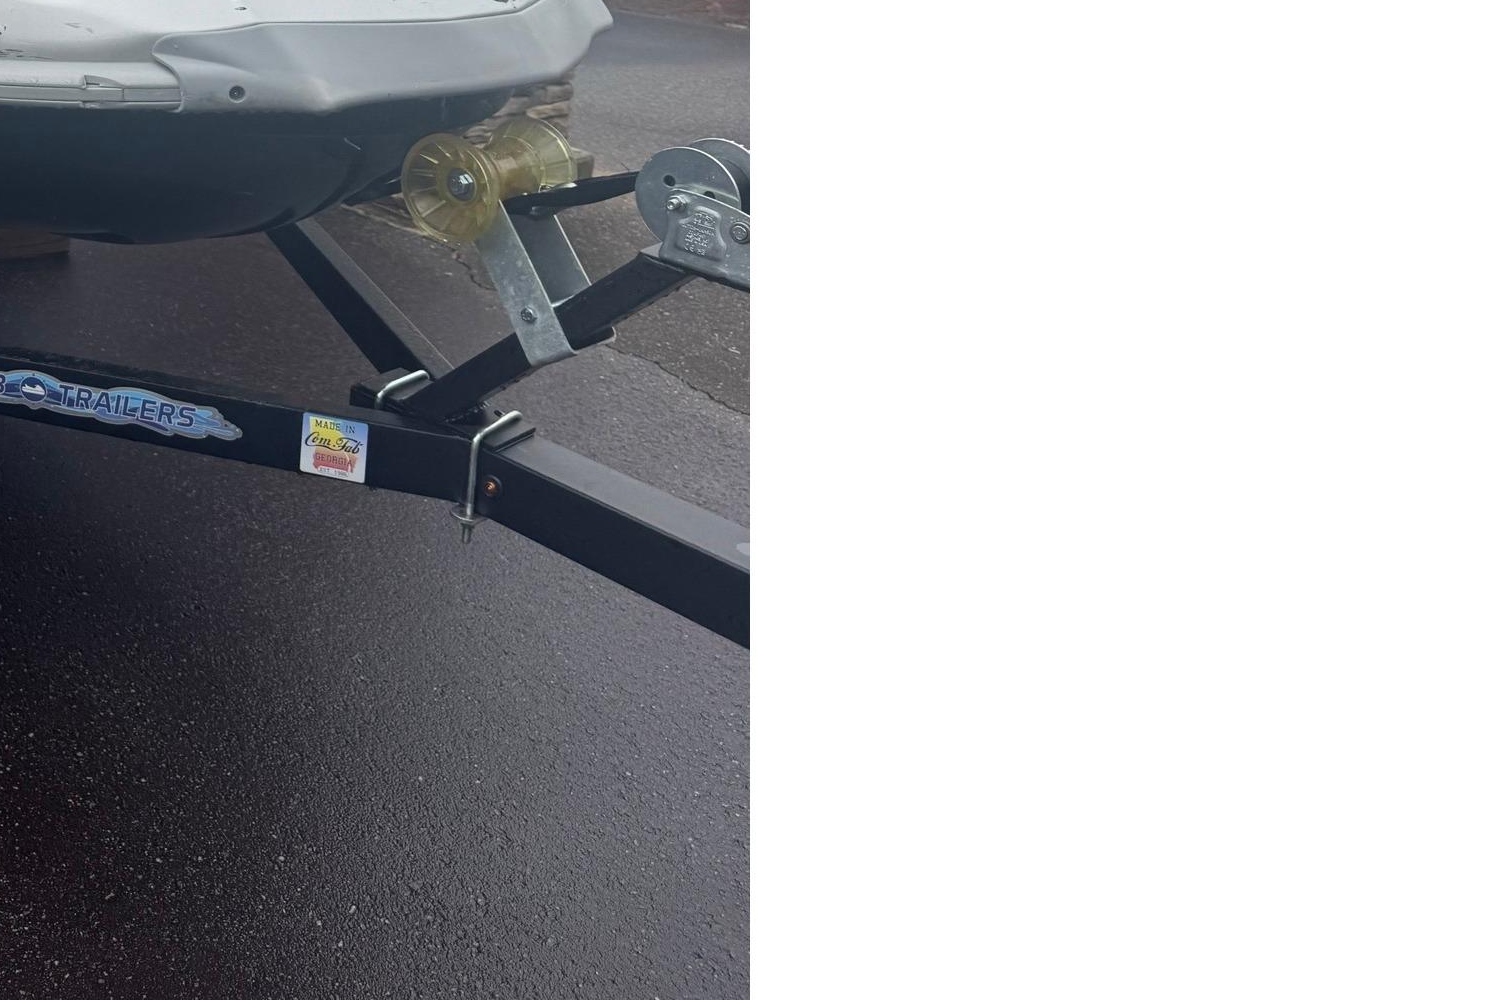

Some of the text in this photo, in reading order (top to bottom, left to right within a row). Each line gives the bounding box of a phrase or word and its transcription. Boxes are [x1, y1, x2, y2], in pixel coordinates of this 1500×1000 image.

[58, 383, 197, 428] TRAILERS
[315, 419, 356, 434] MADE IN
[315, 452, 353, 467] GEORGIA
